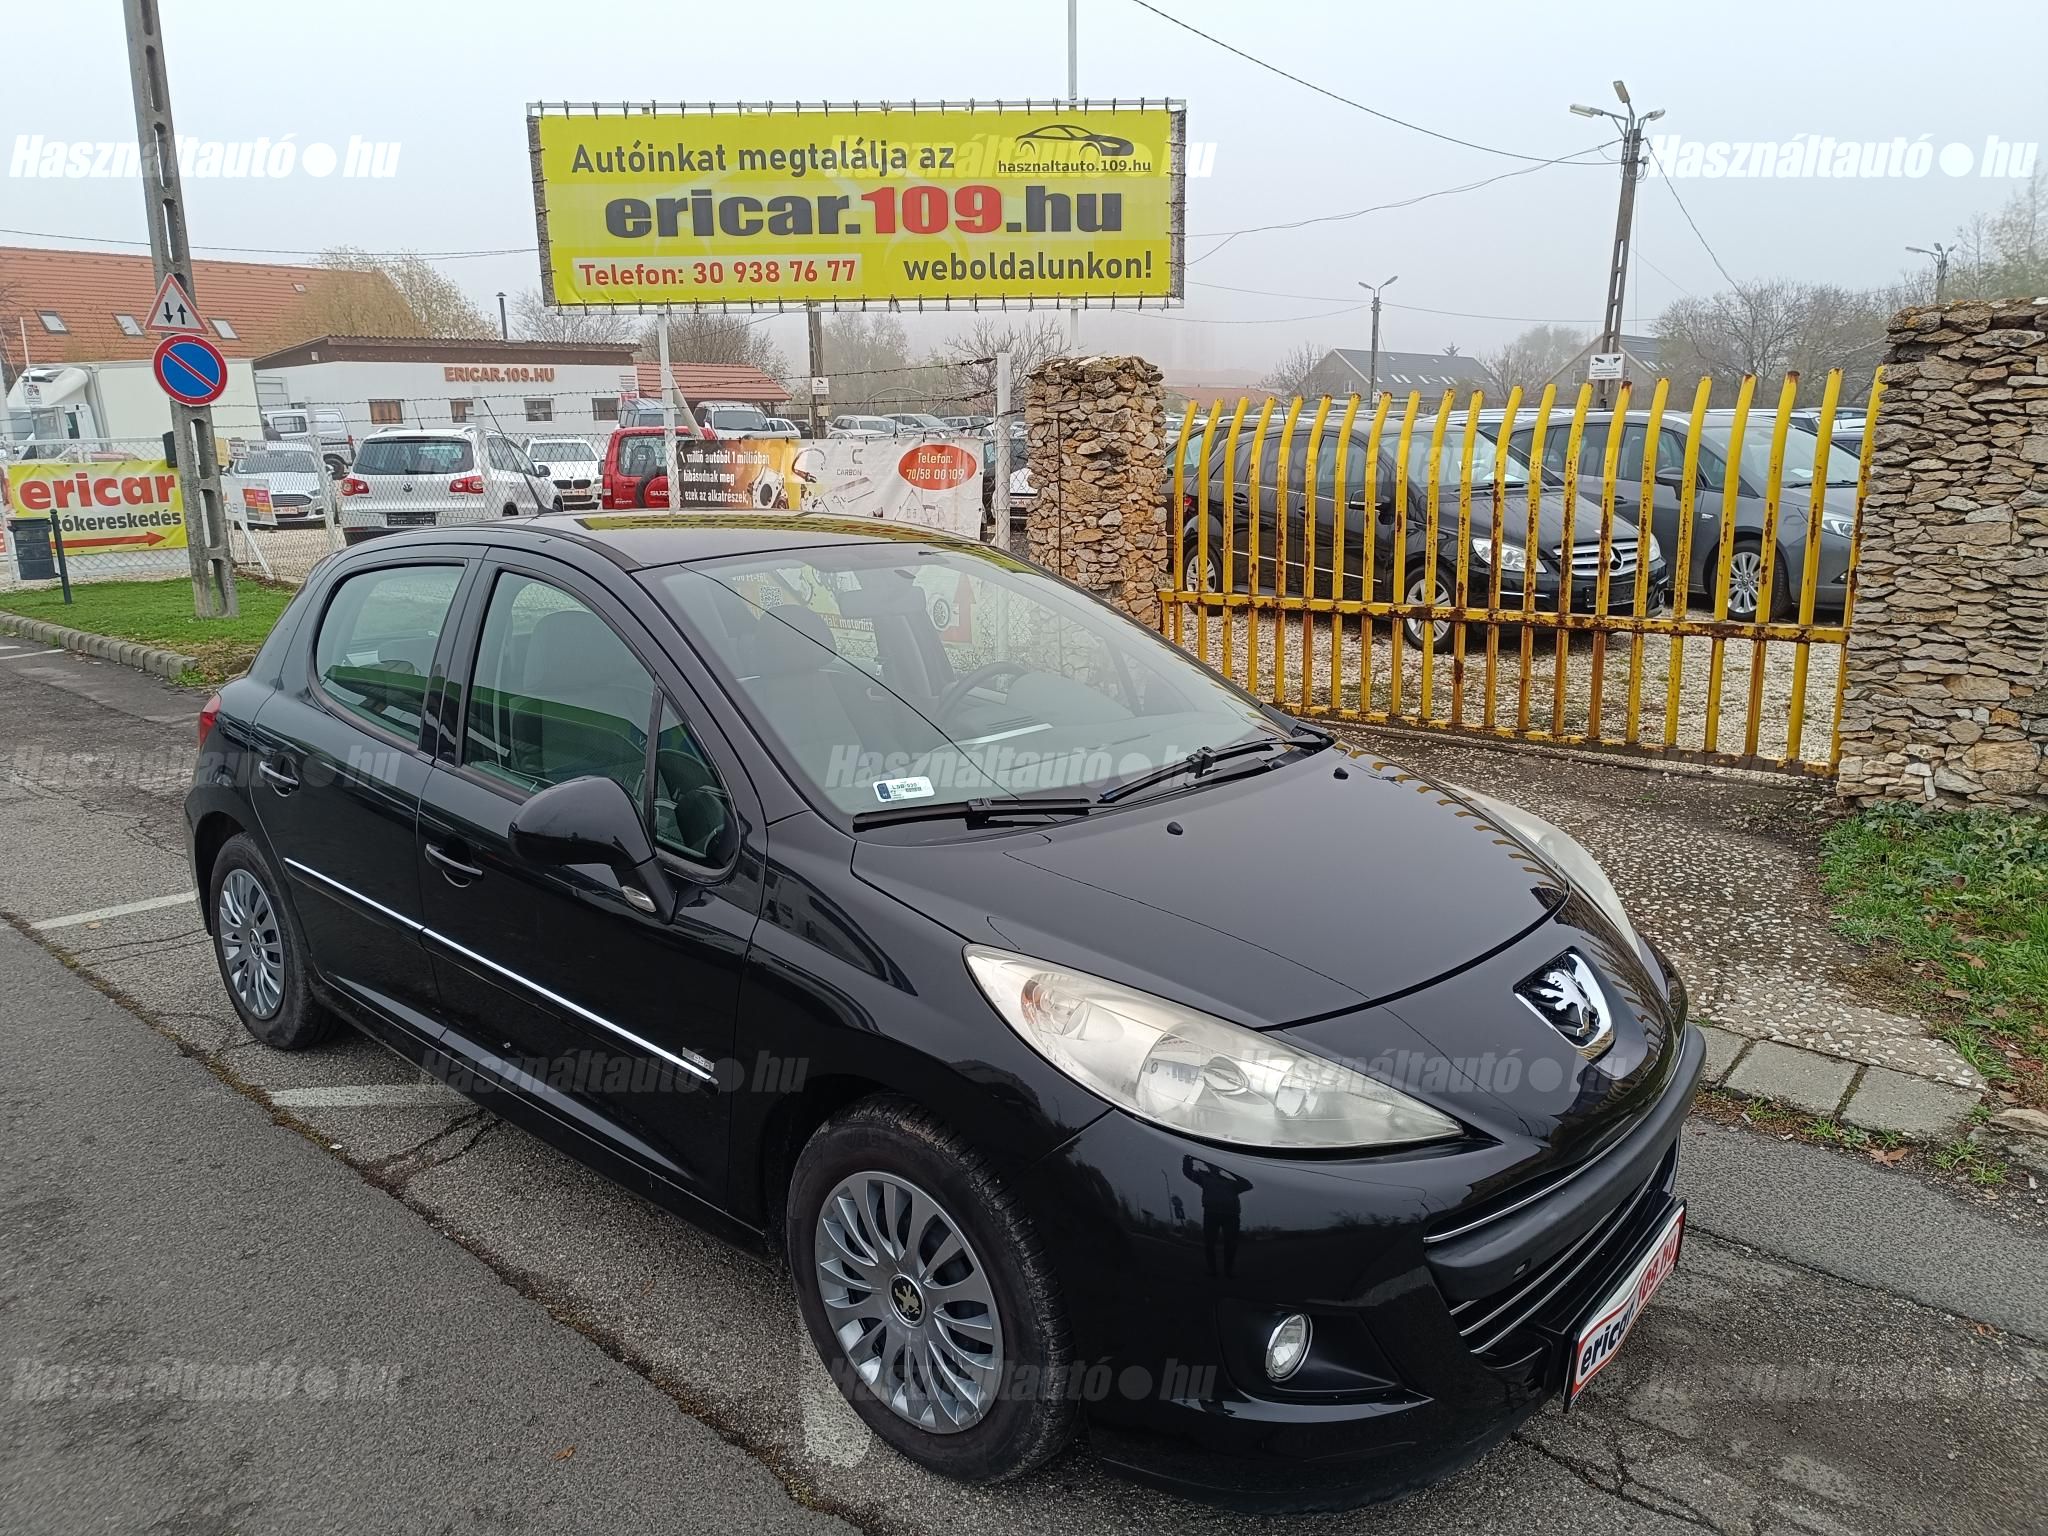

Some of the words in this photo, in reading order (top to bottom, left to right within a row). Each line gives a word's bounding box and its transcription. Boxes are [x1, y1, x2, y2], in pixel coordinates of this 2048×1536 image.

[571, 140, 726, 173] Autóinkat
[739, 137, 907, 177] megtalálja
[919, 144, 954, 169] az
[999, 159, 1152, 172] hasznaltauto.109.hu
[604, 185, 1122, 238] ericar.109.hu
[579, 263, 684, 286] Telefon:
[693, 262, 724, 284] 30
[733, 261, 780, 283] 938
[789, 260, 818, 282] 76
[827, 259, 857, 281] 77
[903, 251, 1153, 281] weboldalunkon!
[444, 366, 555, 382] ERICAR.109.HU
[917, 453, 953, 464] Telefon:
[19, 472, 176, 510] ericar
[719, 473, 735, 486] meg
[55, 508, 182, 533] tókereskedés
